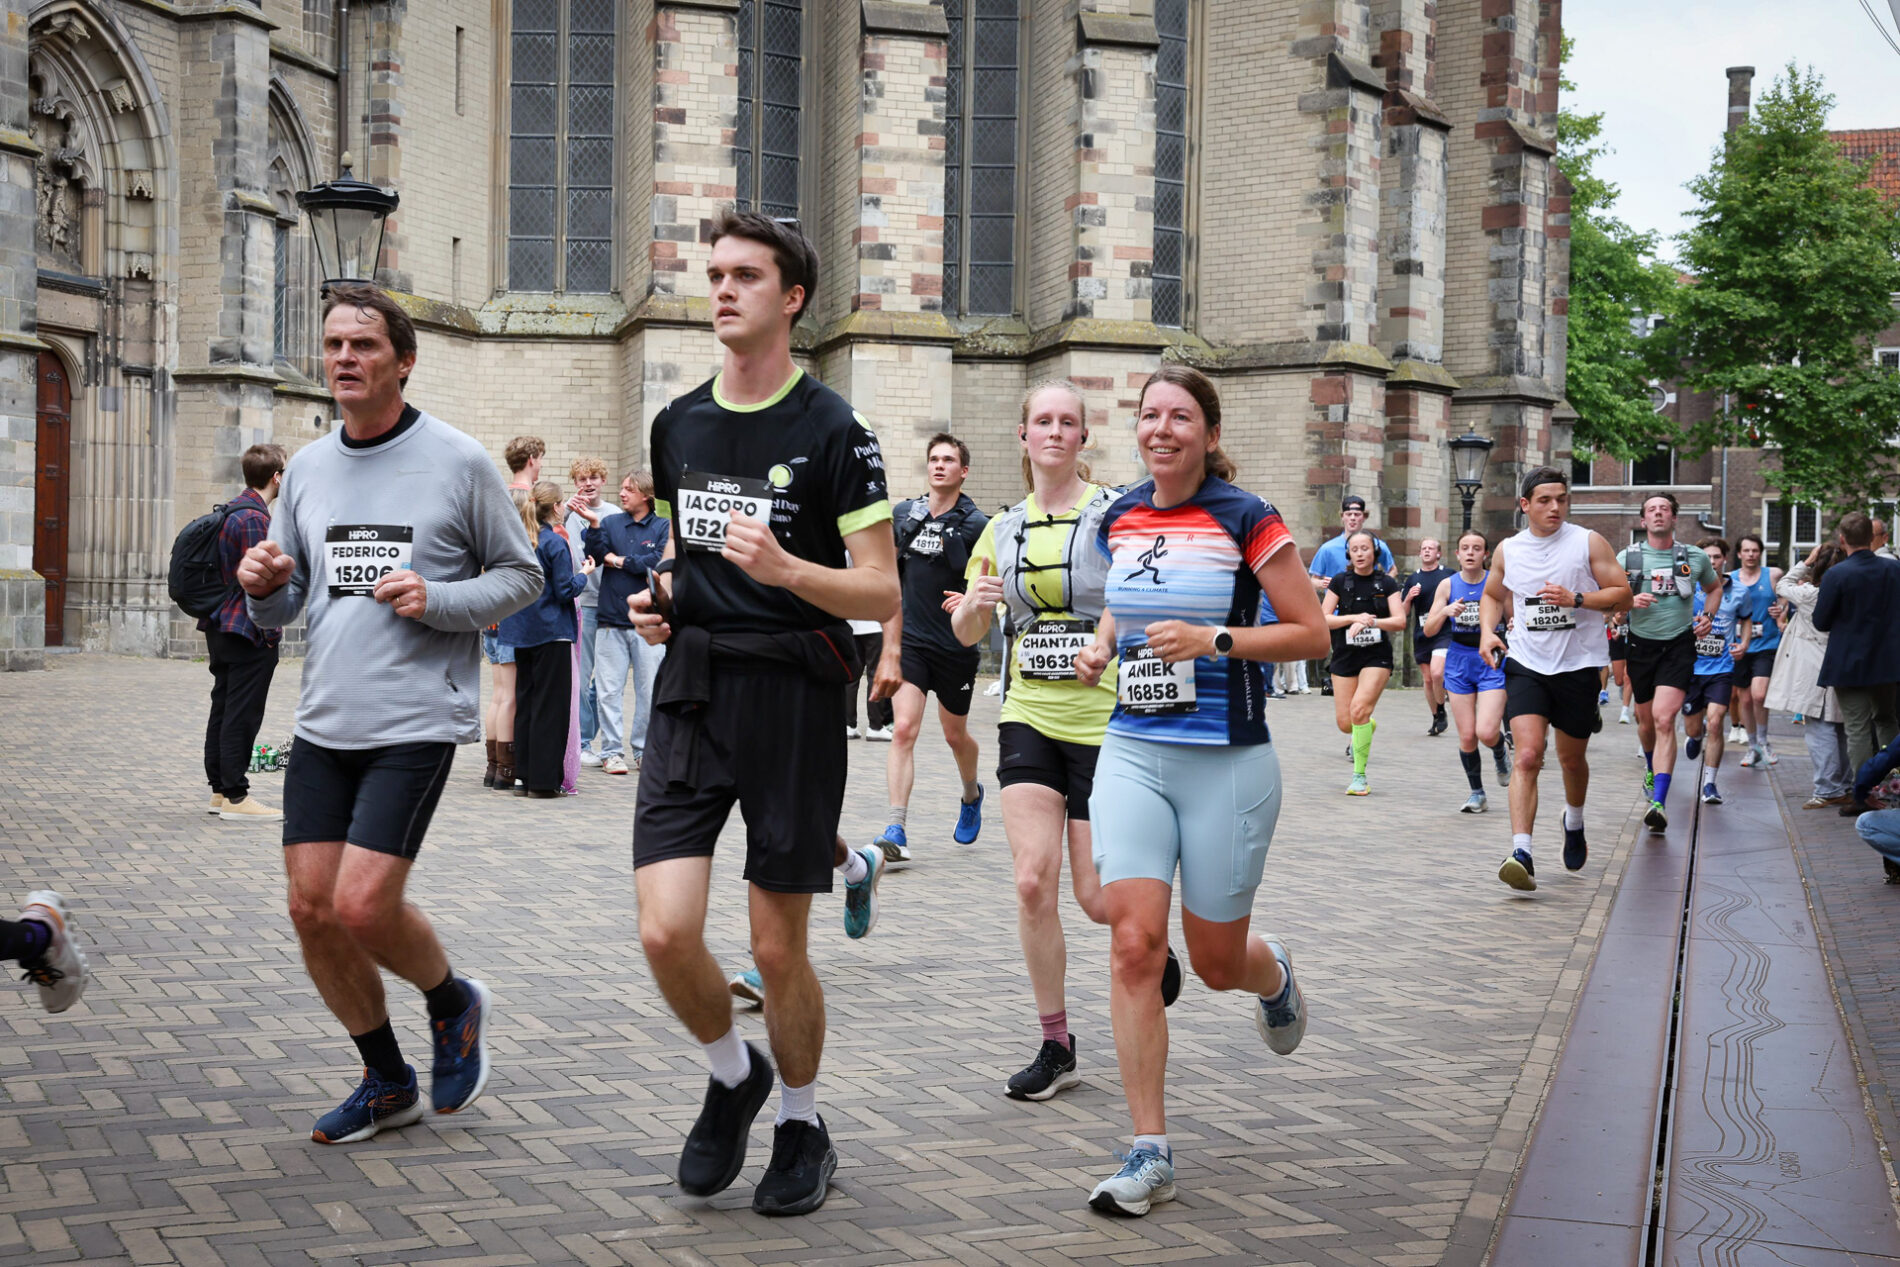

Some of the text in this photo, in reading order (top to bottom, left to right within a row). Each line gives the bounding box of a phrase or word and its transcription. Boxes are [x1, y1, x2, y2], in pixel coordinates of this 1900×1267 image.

[916, 540, 940, 549] 18117
[332, 546, 400, 559] FEDERICO
[1538, 606, 1560, 614] SEM
[1533, 615, 1568, 625] 18204
[1022, 637, 1088, 649] CHANTAL
[1127, 662, 1176, 678] ANIEK
[1127, 682, 1179, 702] 16858
